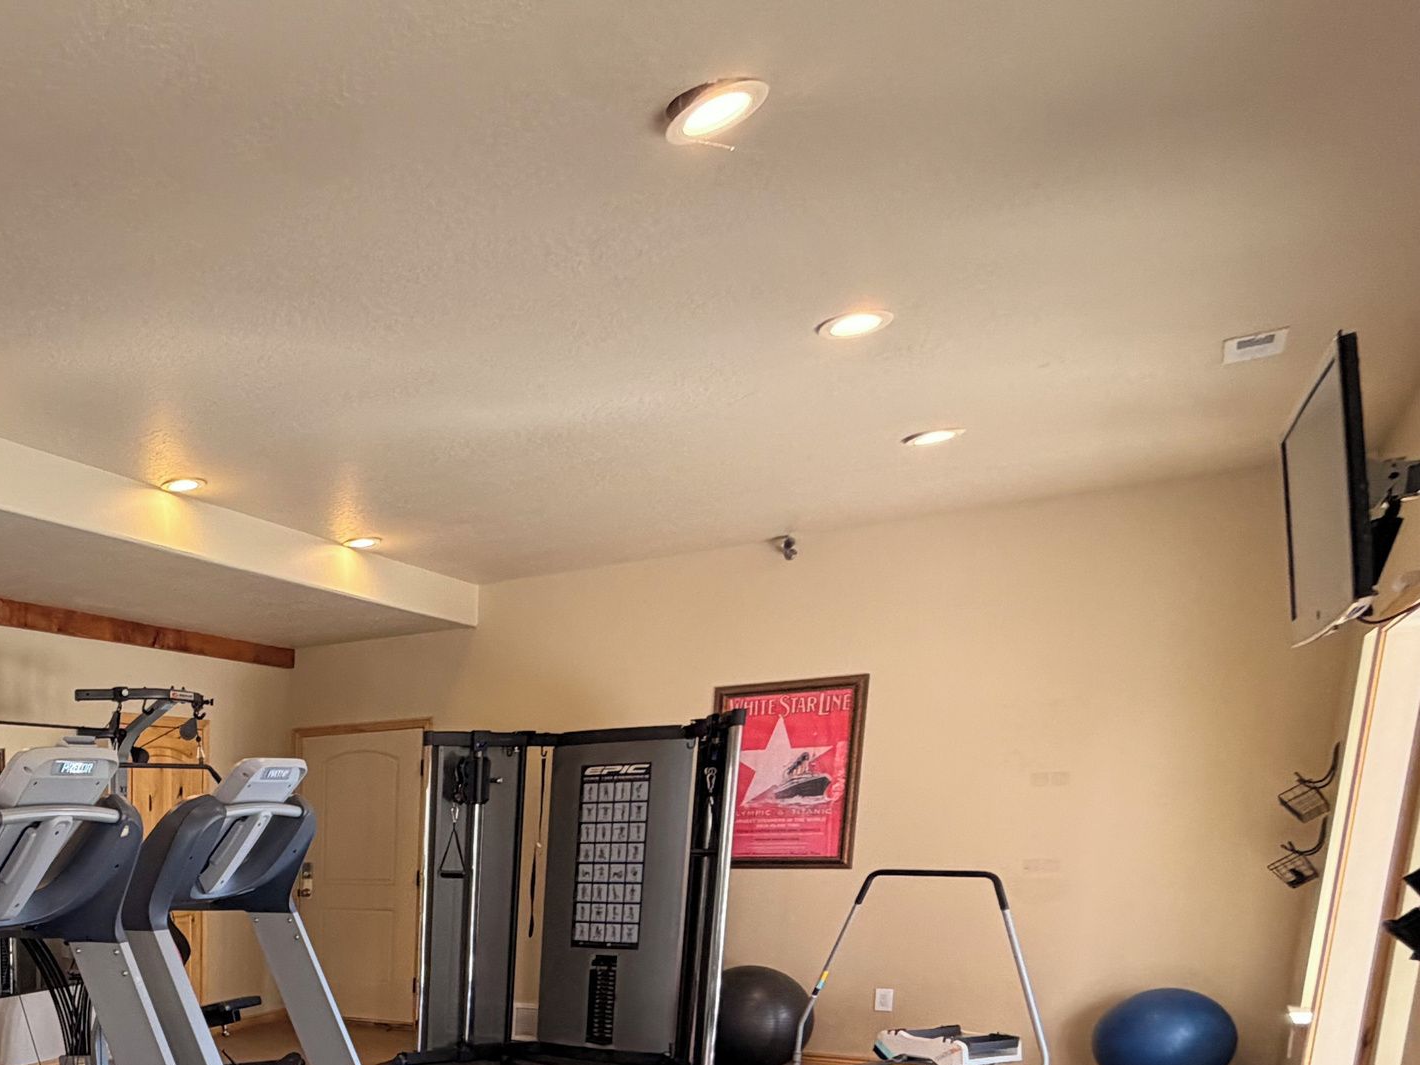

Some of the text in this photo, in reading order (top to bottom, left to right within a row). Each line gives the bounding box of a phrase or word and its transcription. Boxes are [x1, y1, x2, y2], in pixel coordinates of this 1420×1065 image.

[729, 692, 852, 717] WHITE STAR LINE
[584, 763, 651, 776] EPIC
